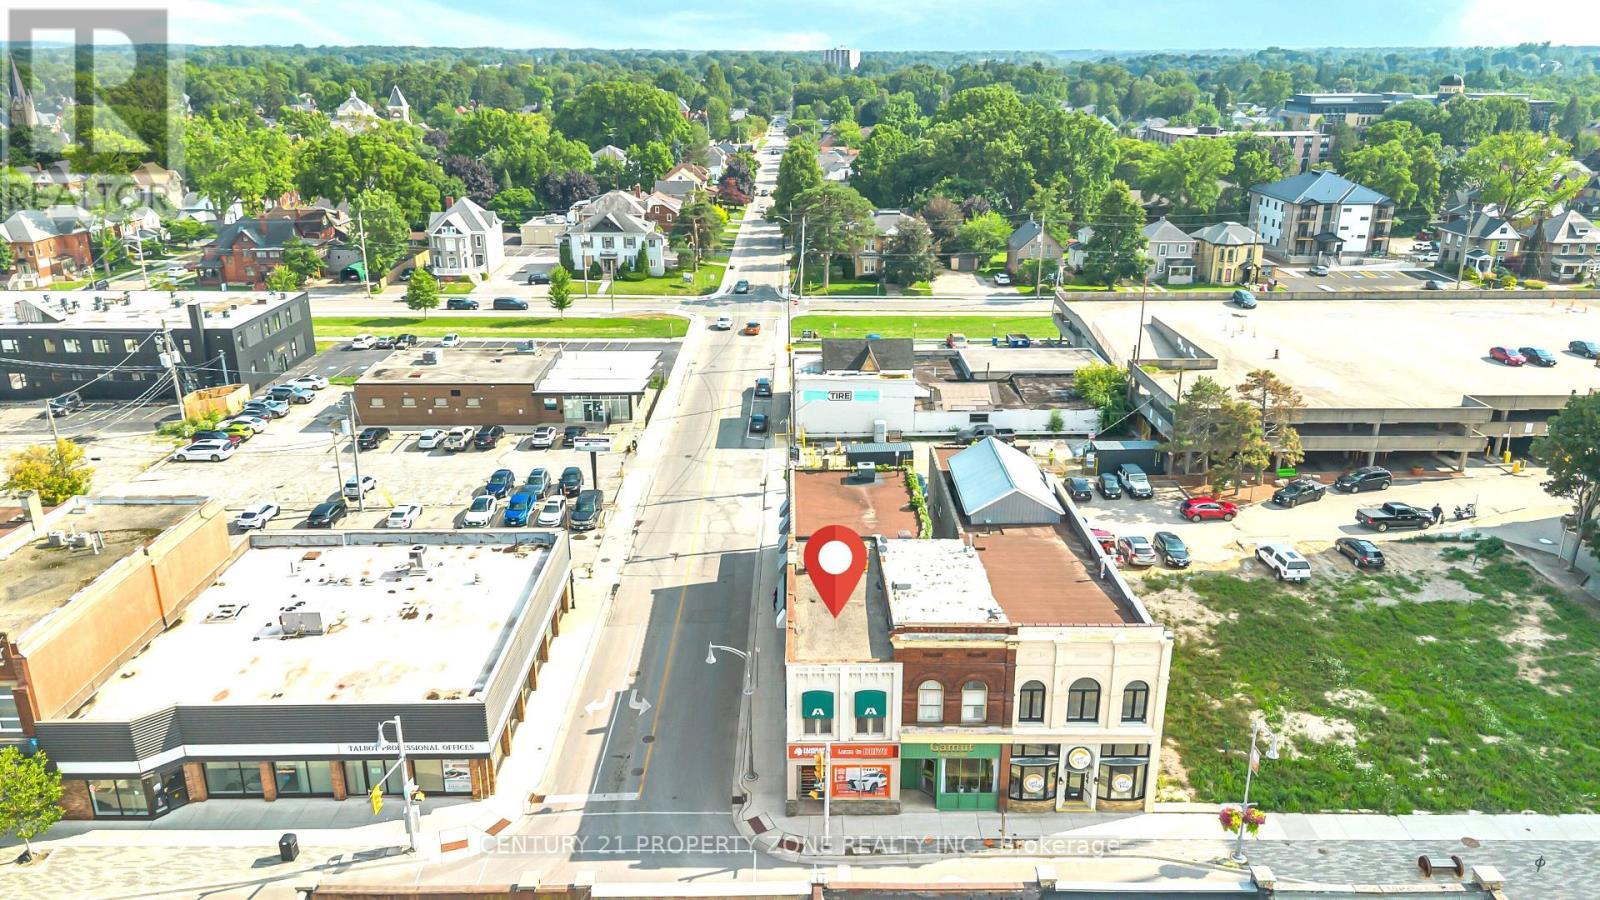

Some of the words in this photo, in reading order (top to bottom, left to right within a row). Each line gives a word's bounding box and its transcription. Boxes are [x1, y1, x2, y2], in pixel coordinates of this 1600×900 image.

[830, 392, 851, 400] TIRE
[349, 744, 379, 752] TALBOT
[442, 743, 475, 751] OFFICES
[929, 742, 975, 753] Gamut
